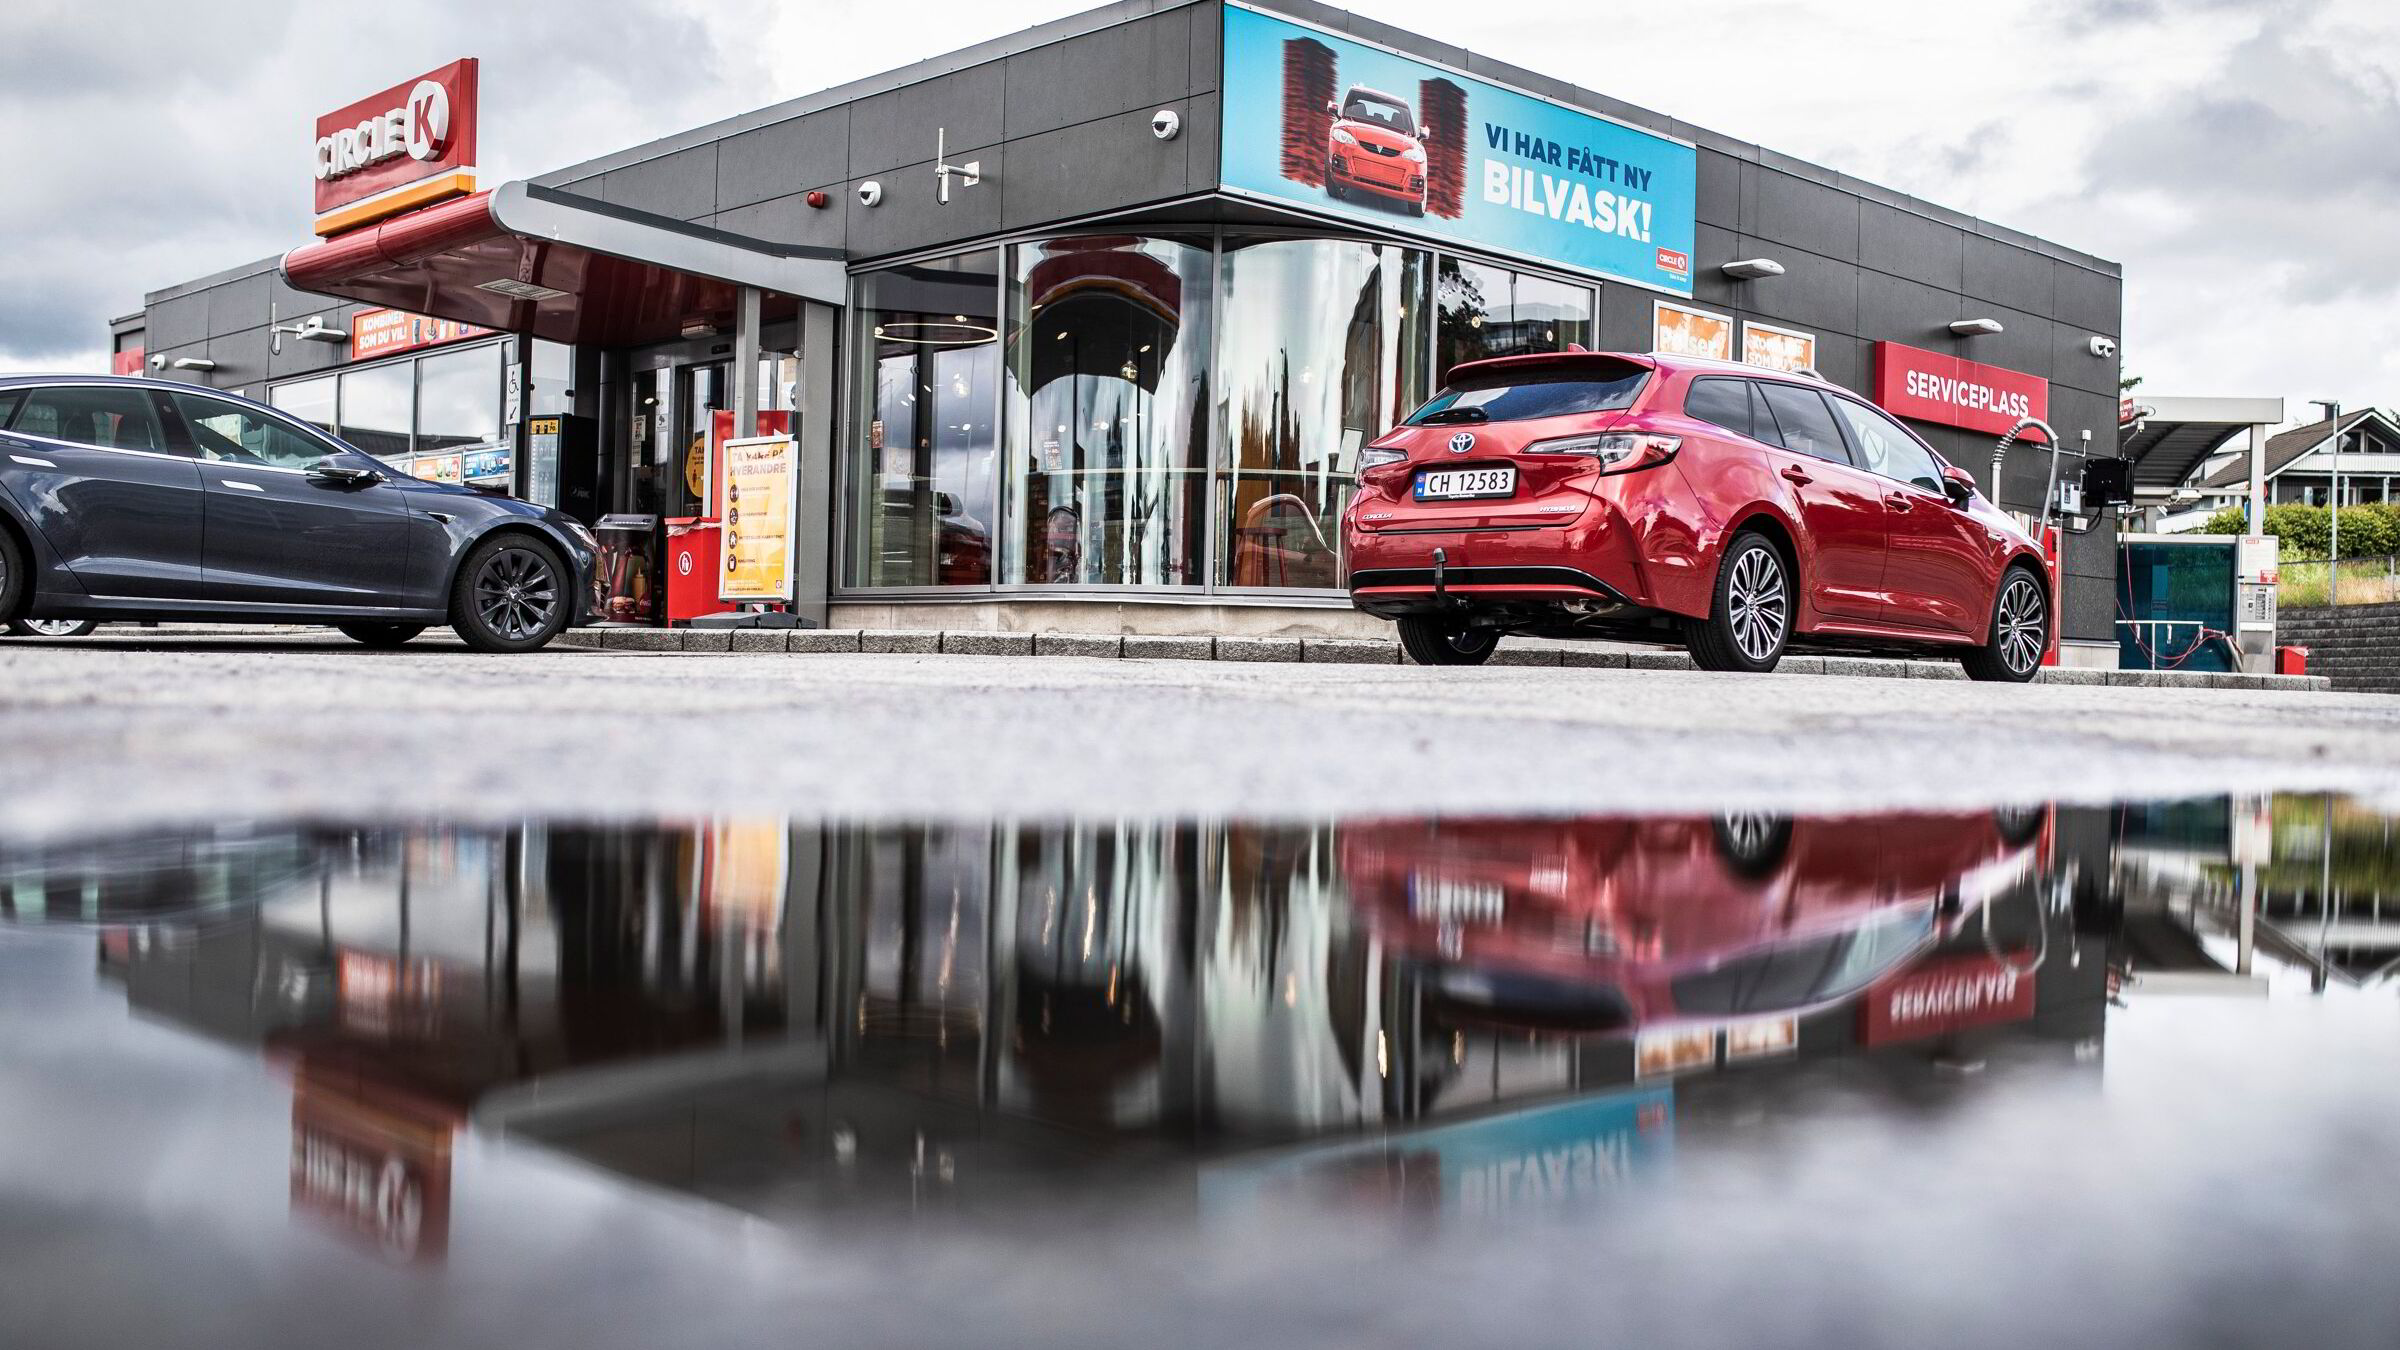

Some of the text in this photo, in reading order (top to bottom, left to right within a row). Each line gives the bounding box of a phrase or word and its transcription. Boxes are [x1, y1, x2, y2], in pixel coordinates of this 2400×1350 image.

[315, 107, 406, 180] CIRCLE
[1485, 123, 1652, 192] VI HAR FÅTT NY
[1483, 158, 1652, 243] BILVASK!
[359, 333, 376, 350] SOM
[378, 330, 389, 345] DU
[391, 326, 407, 342] VIL!
[363, 311, 405, 331] KOMBINER
[1906, 369, 2029, 418] SERVICEPLASS
[730, 463, 786, 477] HVERANDRE
[1429, 472, 1508, 492] CH 12583
